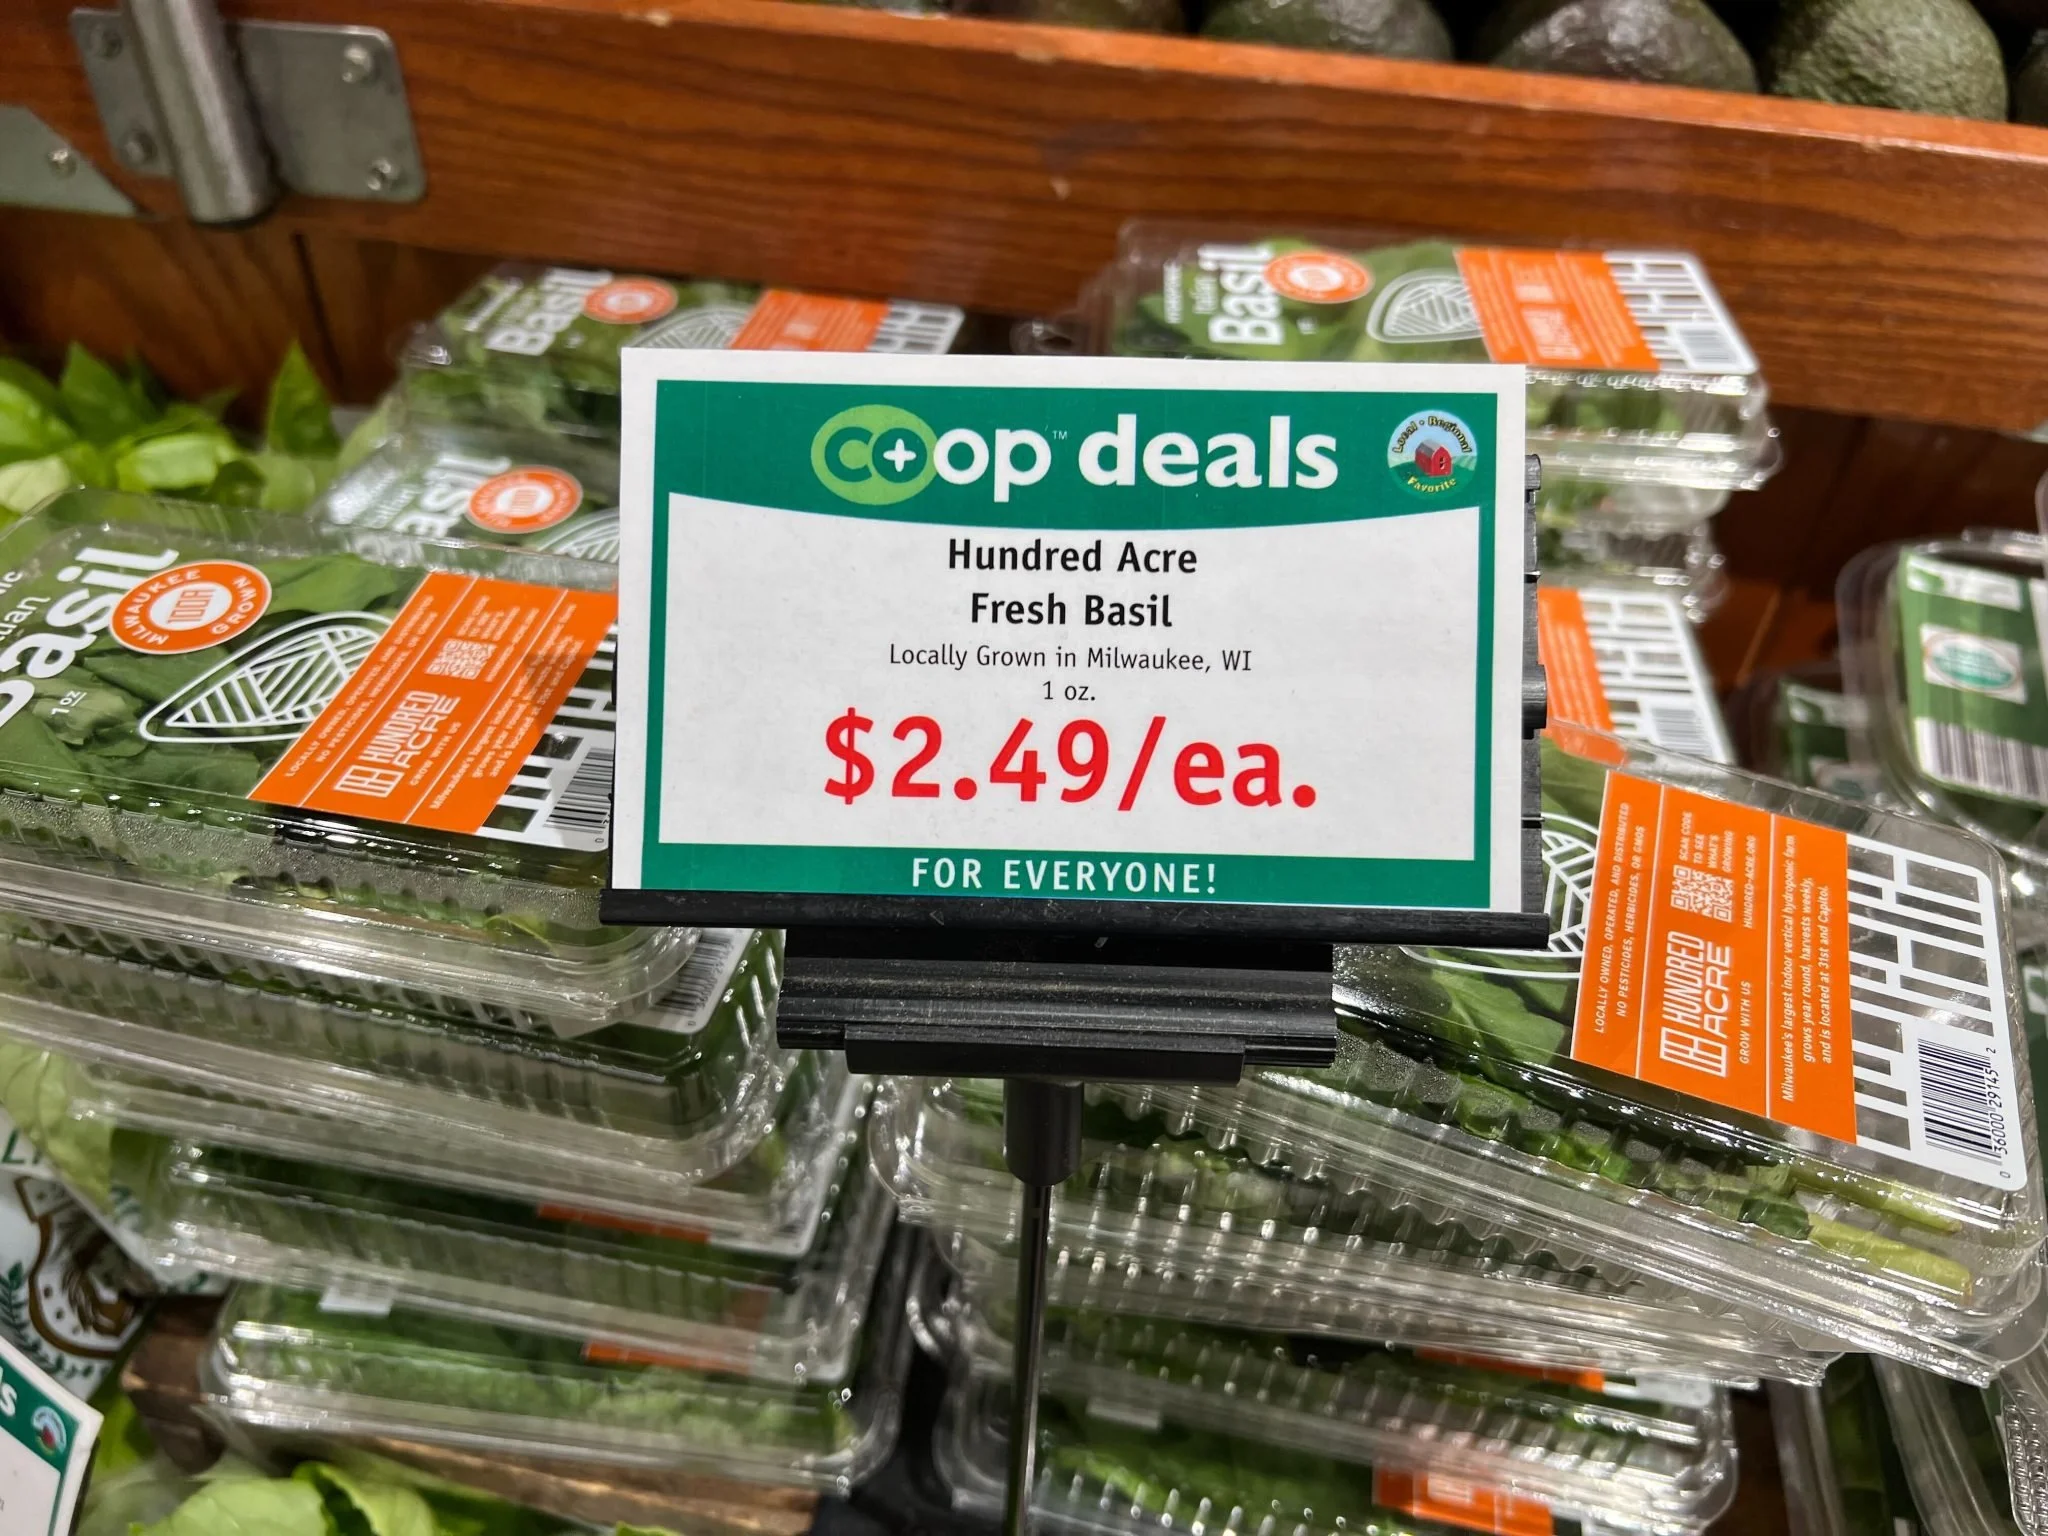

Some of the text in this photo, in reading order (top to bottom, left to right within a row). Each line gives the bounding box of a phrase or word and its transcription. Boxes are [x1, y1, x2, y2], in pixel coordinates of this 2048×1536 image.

[484, 266, 612, 356] Basil
[1197, 243, 1284, 345] Basil
[1078, 412, 1339, 490] deals
[1392, 419, 1419, 454] Local
[1406, 475, 1458, 494] Favorite
[950, 539, 1197, 573] Hundred Acre
[123, 568, 202, 646] MILWAUKEE
[209, 574, 258, 636] GROWN
[972, 593, 1172, 627] Fresh Basil
[891, 644, 1251, 672] Locally Grown in Milwaukee, WI
[51, 689, 82, 716] 1 oz
[1044, 681, 1095, 700] 1 oz.
[315, 749, 332, 762] NO
[327, 699, 373, 748] PESTICIDES,
[356, 689, 440, 763] HUNDRED
[391, 694, 461, 768] ACRE
[284, 740, 322, 776] LOCALLY
[408, 760, 434, 785] GROW
[472, 750, 498, 778] grows
[491, 730, 511, 749] year
[488, 759, 507, 776] and
[825, 708, 1316, 811] $2.49/ea.
[429, 755, 475, 809] Milwaukee's
[1679, 811, 1691, 861] SCAN CODE
[1693, 833, 1704, 865] TO SEE
[1707, 833, 1718, 869] WHAT'S
[1722, 829, 1733, 873] GROWING
[913, 858, 1214, 893] FOR EVERYONE!
[1631, 855, 1641, 869] OR
[1593, 802, 1630, 1032] LOCALLY OWNED, OPERATED, AND DISTRIBUTED
[1624, 871, 1641, 932] HERBICIDES,
[1616, 935, 1634, 997] PESTICIDES,
[1659, 930, 1706, 1028] HUNDRED
[1700, 940, 1732, 1038] ACRE
[1780, 834, 1796, 1101] Milwaukee's largest indoor vertical hydroponic farm
[1800, 876, 1813, 1062] grows year round, harvests weekly,
[1817, 884, 1831, 1063] and is located at 31st and Capitol.
[1616, 1000, 1627, 1016] NO
[1738, 980, 1750, 1064] GROW WITH US
[1985, 1069, 2003, 1108] 29145
[1990, 1113, 2008, 1156] 36000
[2000, 1171, 2011, 1179] 0
